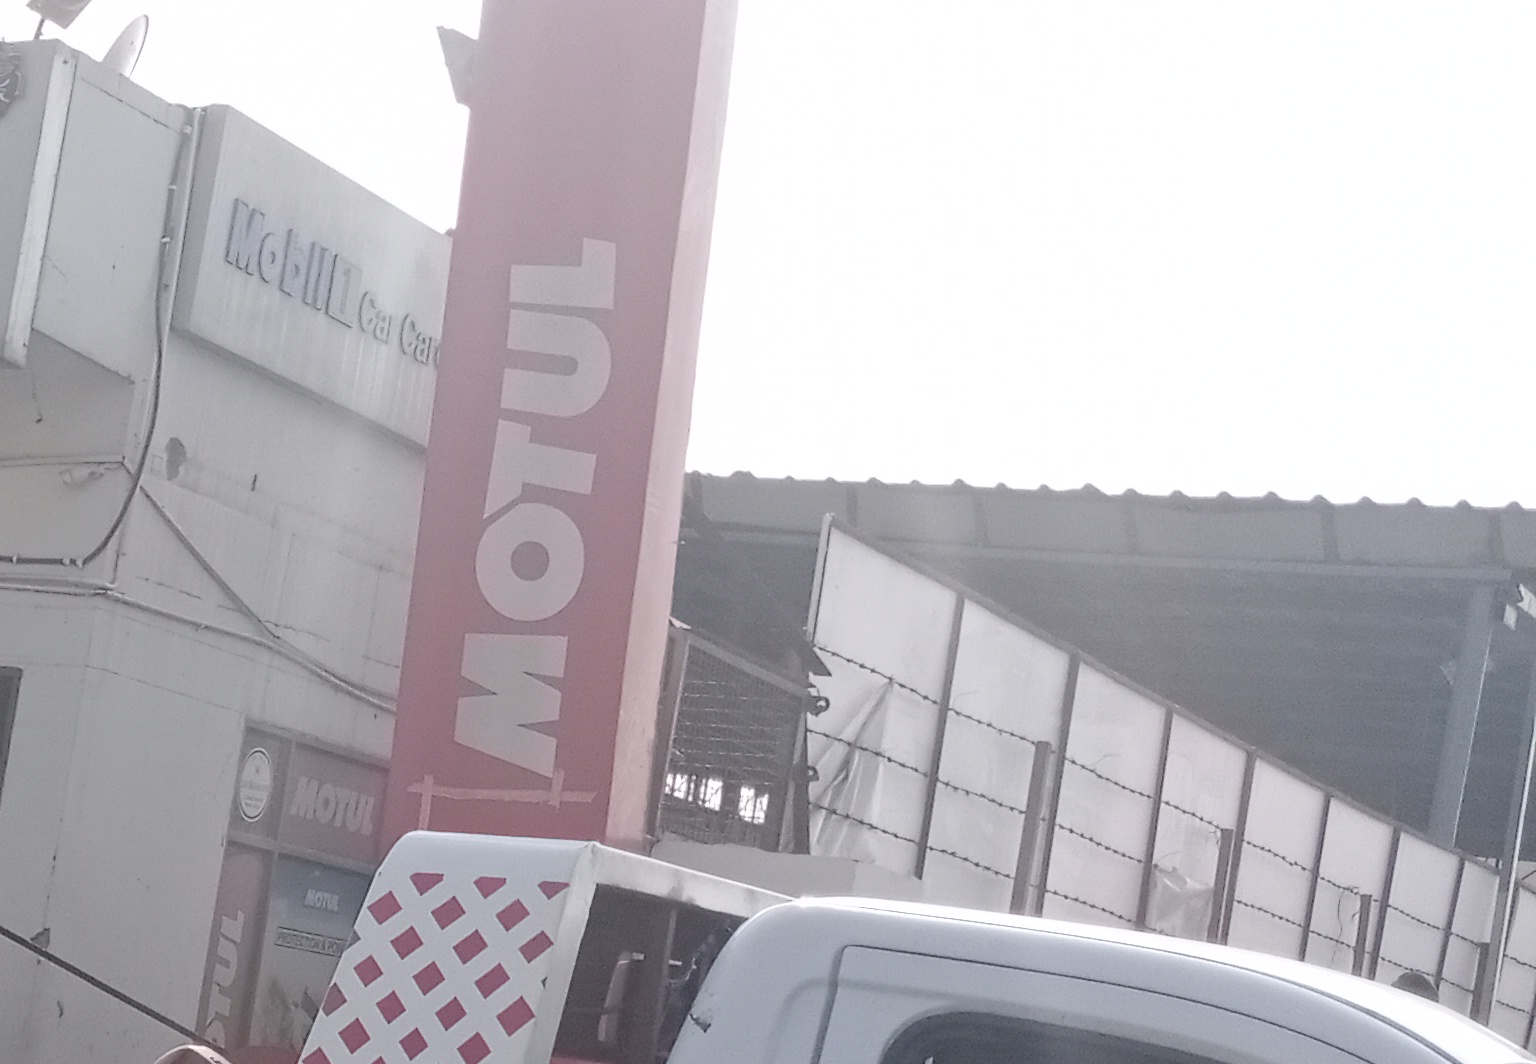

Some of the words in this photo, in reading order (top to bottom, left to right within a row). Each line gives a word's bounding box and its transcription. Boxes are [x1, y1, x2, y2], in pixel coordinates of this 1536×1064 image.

[454, 237, 617, 778] MOTUL
[290, 775, 375, 837] MOTUL
[305, 888, 340, 913] MOTUL
